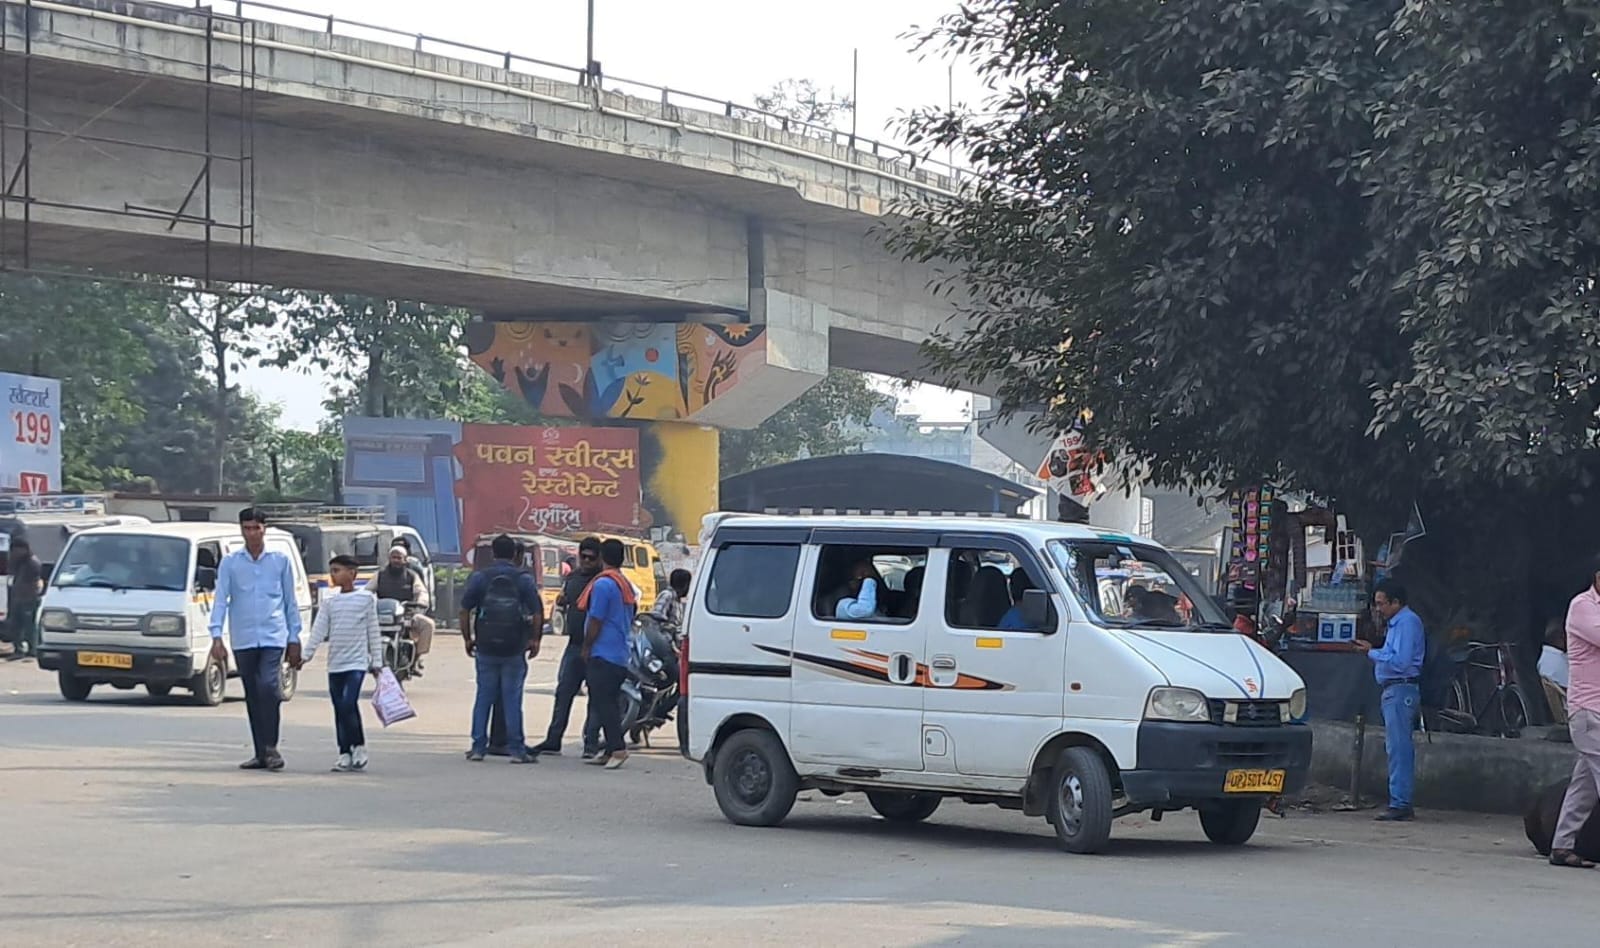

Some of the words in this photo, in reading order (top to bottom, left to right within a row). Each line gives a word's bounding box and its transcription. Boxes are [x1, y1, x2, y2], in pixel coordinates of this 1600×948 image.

[14, 410, 51, 446] 199
[476, 443, 535, 466] पवन
[544, 440, 635, 478] स्वीट्स
[521, 470, 621, 498] रेस्टोरेन्ट
